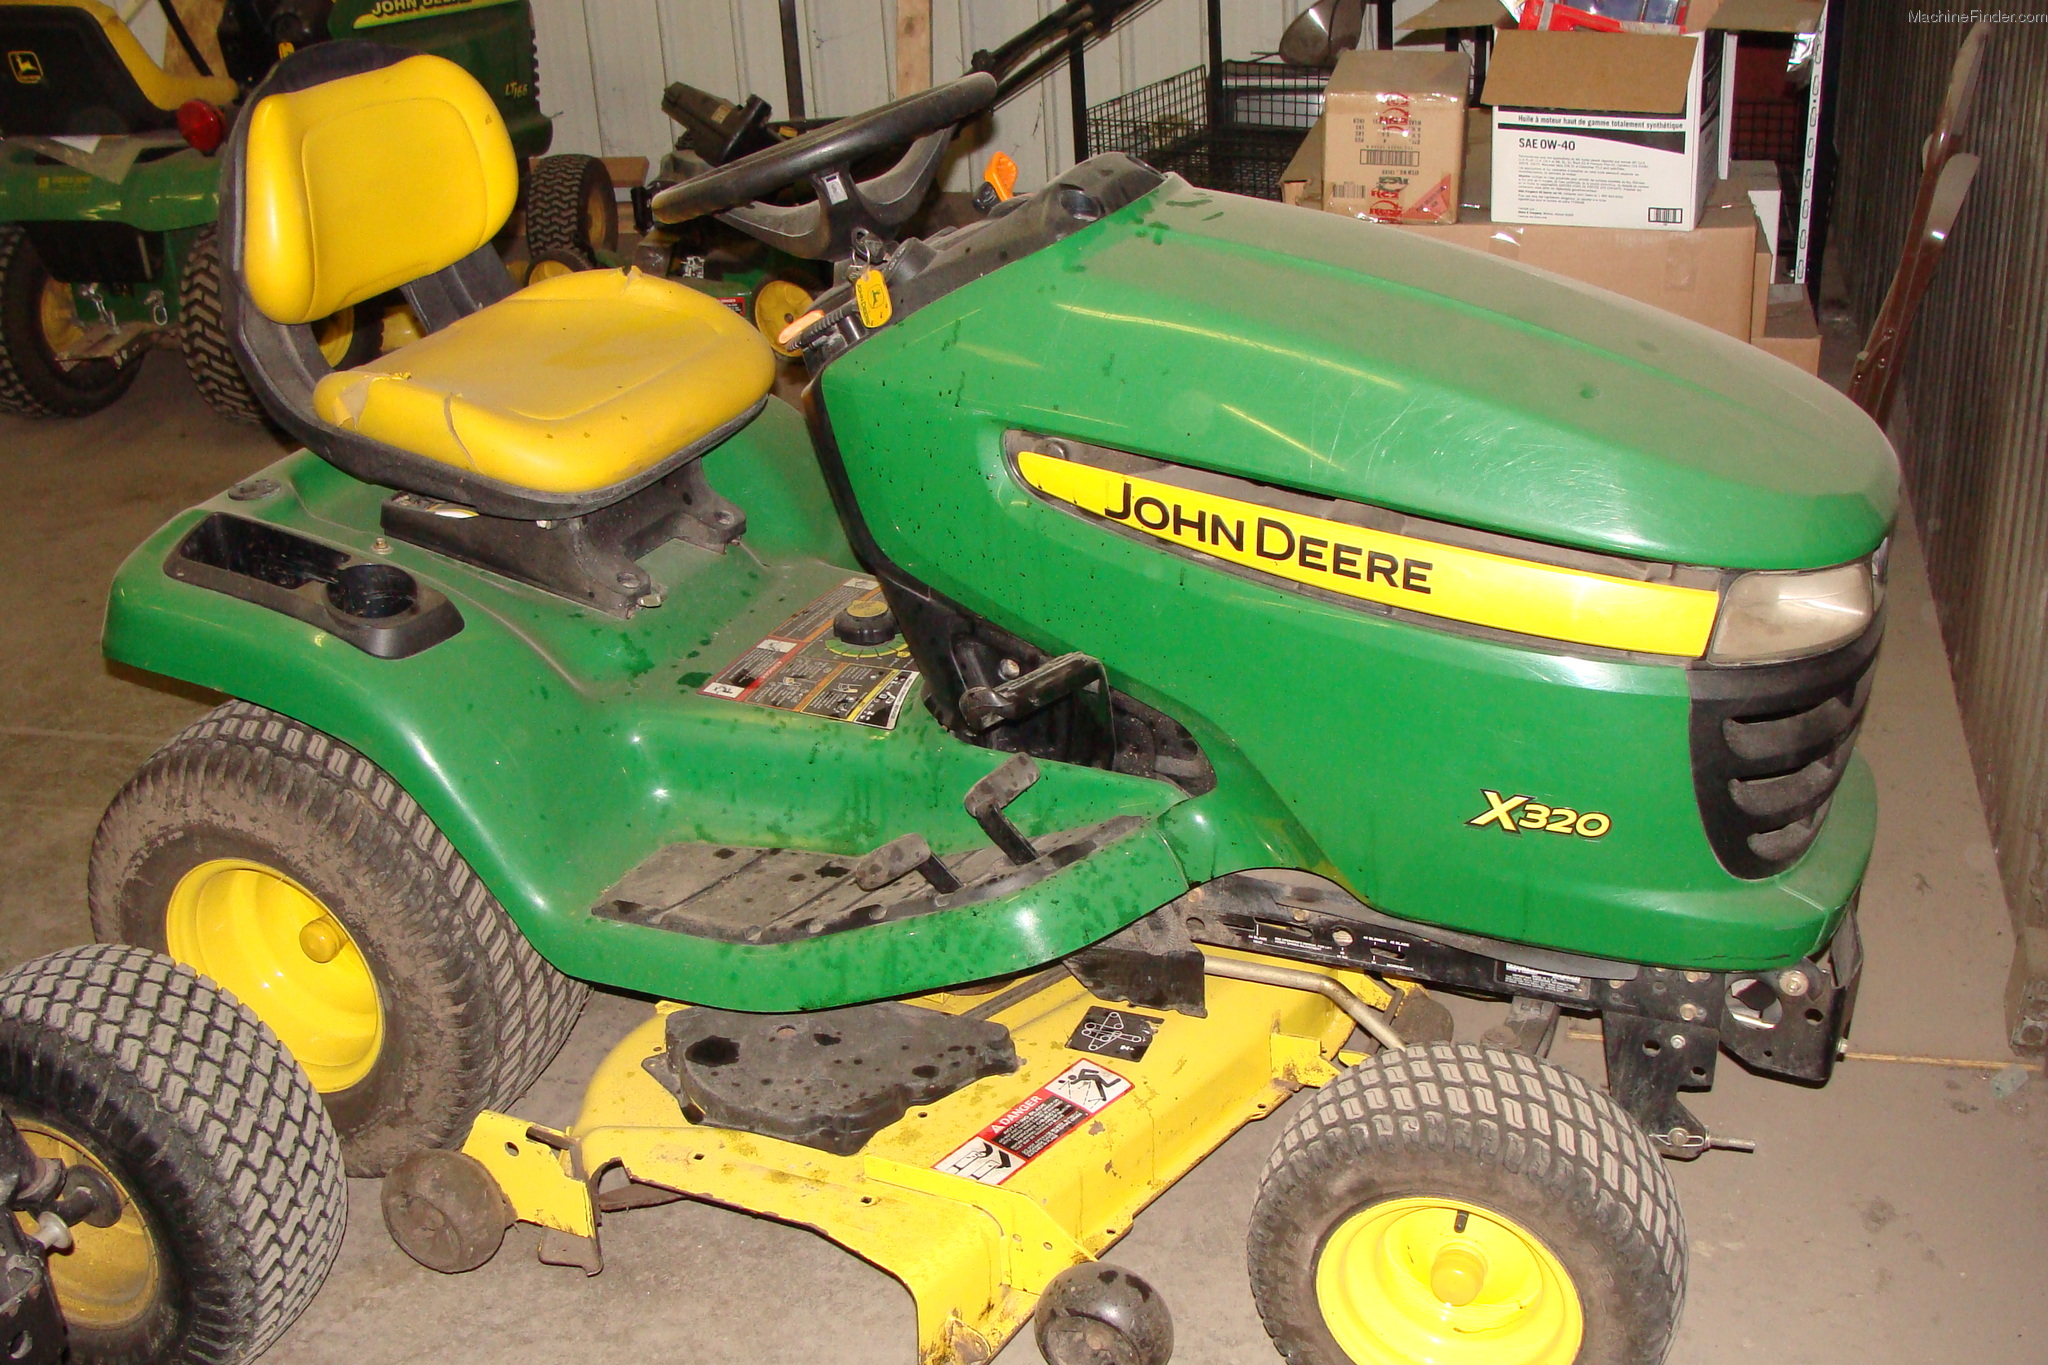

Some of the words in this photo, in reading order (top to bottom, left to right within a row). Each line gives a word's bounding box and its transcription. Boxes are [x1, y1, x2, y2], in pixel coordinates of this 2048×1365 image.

[371, 0, 417, 16] JOHN
[1518, 115, 1534, 123] Huile
[1563, 117, 1577, 125] haut
[1587, 119, 1610, 127] gamme
[1611, 120, 1645, 128] totalement
[1646, 121, 1683, 130] synthétique
[1519, 138, 1538, 149] SAE
[1540, 139, 1576, 151] 0W-40
[1104, 482, 1245, 553] JOHN
[1256, 516, 1434, 595] DEERE
[1464, 788, 1613, 838] X320
[999, 1095, 1043, 1126] DANGER
